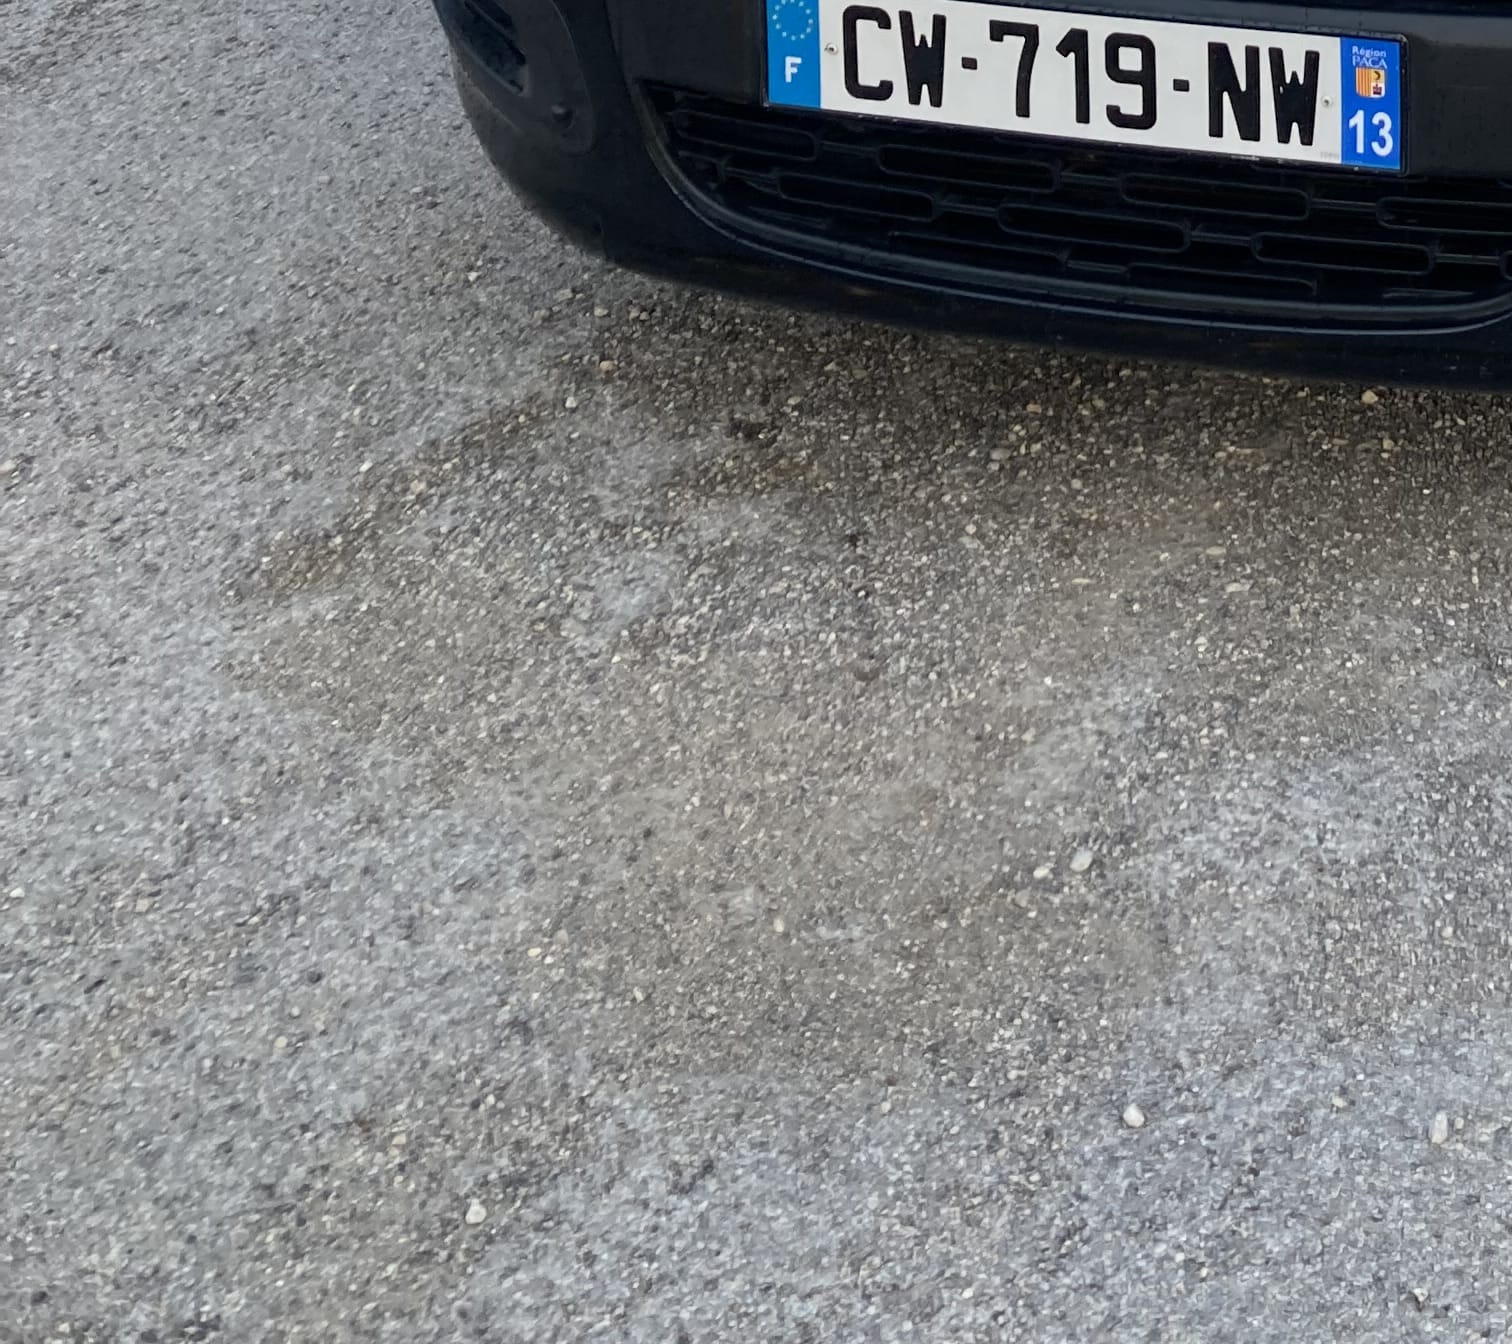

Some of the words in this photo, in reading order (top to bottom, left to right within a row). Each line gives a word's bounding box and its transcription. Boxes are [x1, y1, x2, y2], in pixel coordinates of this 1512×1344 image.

[1352, 45, 1387, 59] Région
[1352, 55, 1388, 69] PACA
[785, 55, 803, 83] F
[842, 4, 1320, 147] CW-719-NW
[1348, 109, 1394, 157] 13
